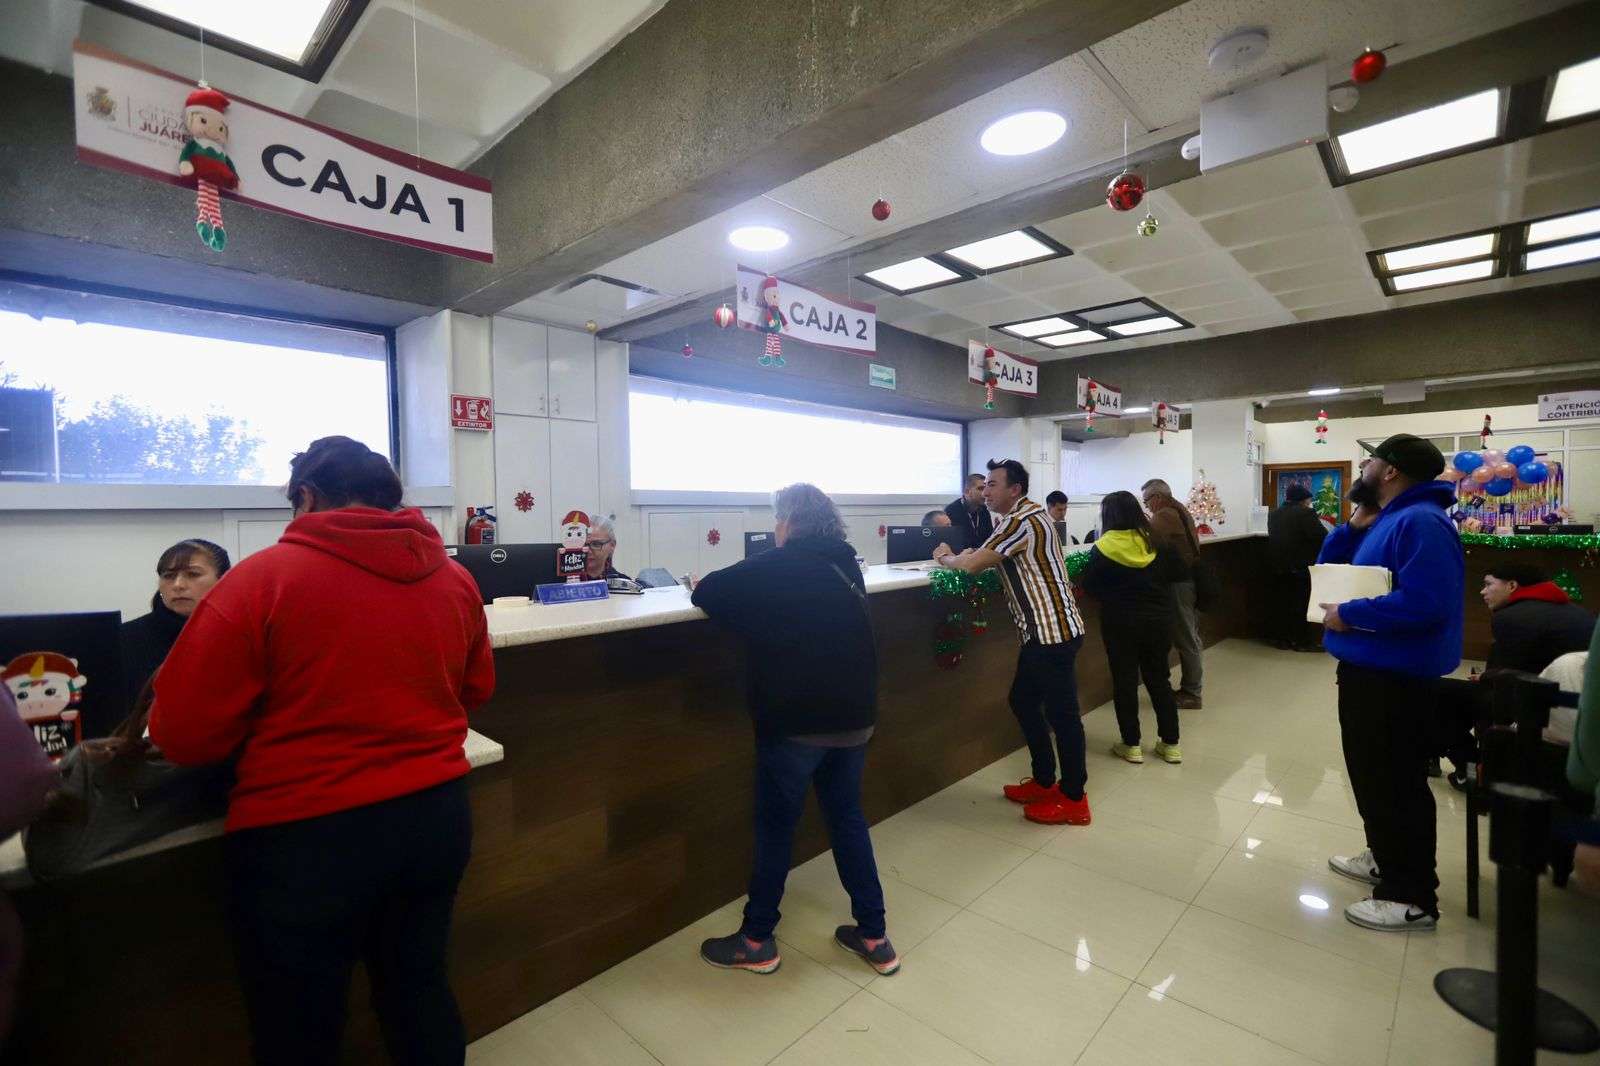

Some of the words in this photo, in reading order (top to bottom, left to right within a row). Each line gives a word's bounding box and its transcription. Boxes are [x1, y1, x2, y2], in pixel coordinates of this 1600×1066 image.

[138, 108, 187, 130] CIUDA
[139, 121, 191, 144] JUÁRE
[261, 143, 431, 225] CAJA
[447, 196, 465, 233] 1
[789, 301, 849, 337] CAJA
[855, 318, 867, 341] 2
[1026, 370, 1033, 386] 3
[1096, 392, 1111, 408] AJA
[1112, 396, 1118, 409] 4
[457, 421, 488, 429] EXTINTOR
[549, 586, 602, 600] ABIERTO
[33, 724, 61, 744] liz
